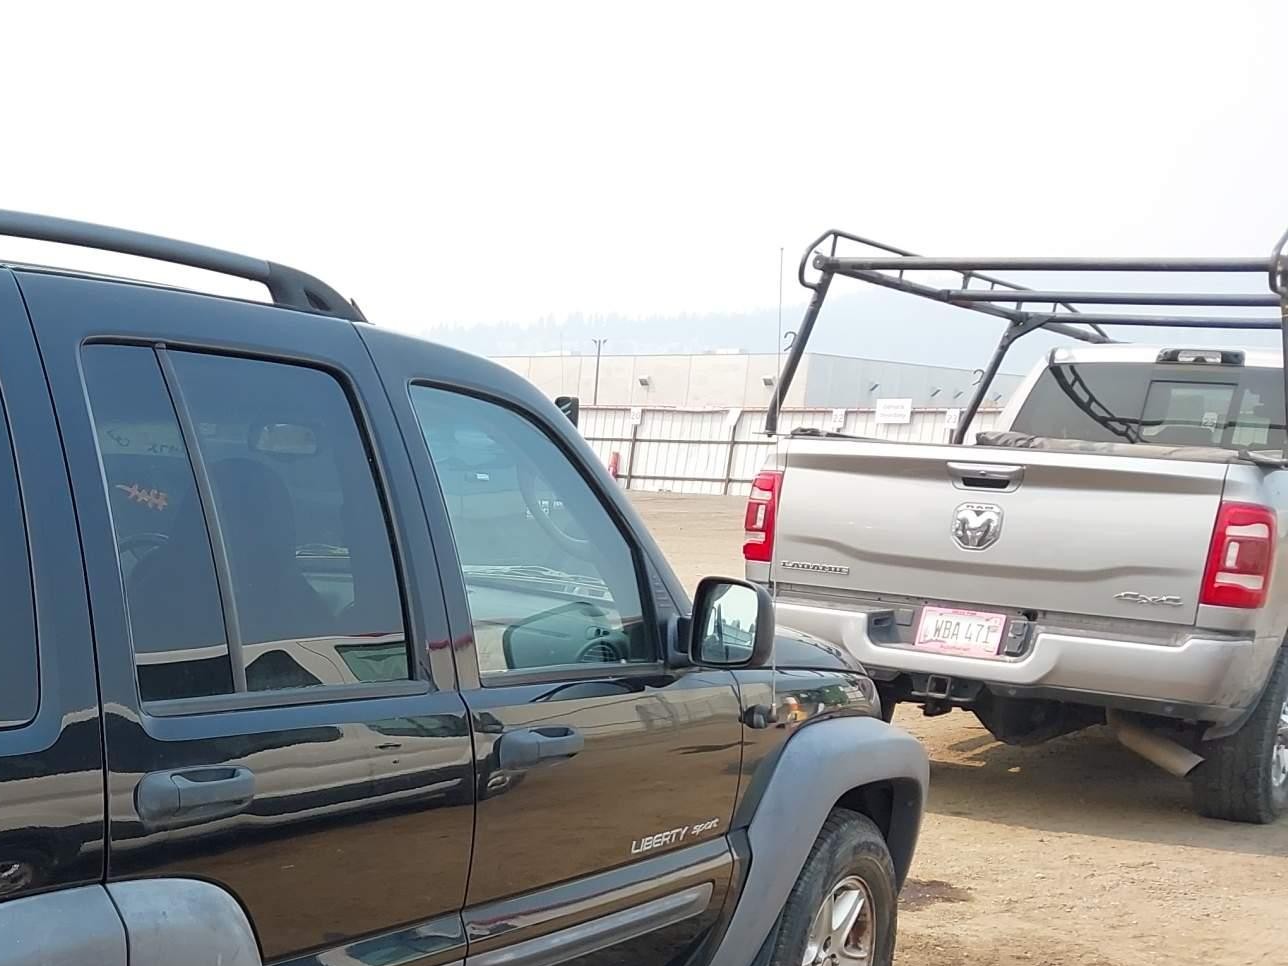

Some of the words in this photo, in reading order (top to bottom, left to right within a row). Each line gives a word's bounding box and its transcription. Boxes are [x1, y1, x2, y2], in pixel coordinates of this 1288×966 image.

[933, 619, 960, 641] WBA
[631, 826, 689, 854] LIBERTY
[691, 818, 720, 836] sport
